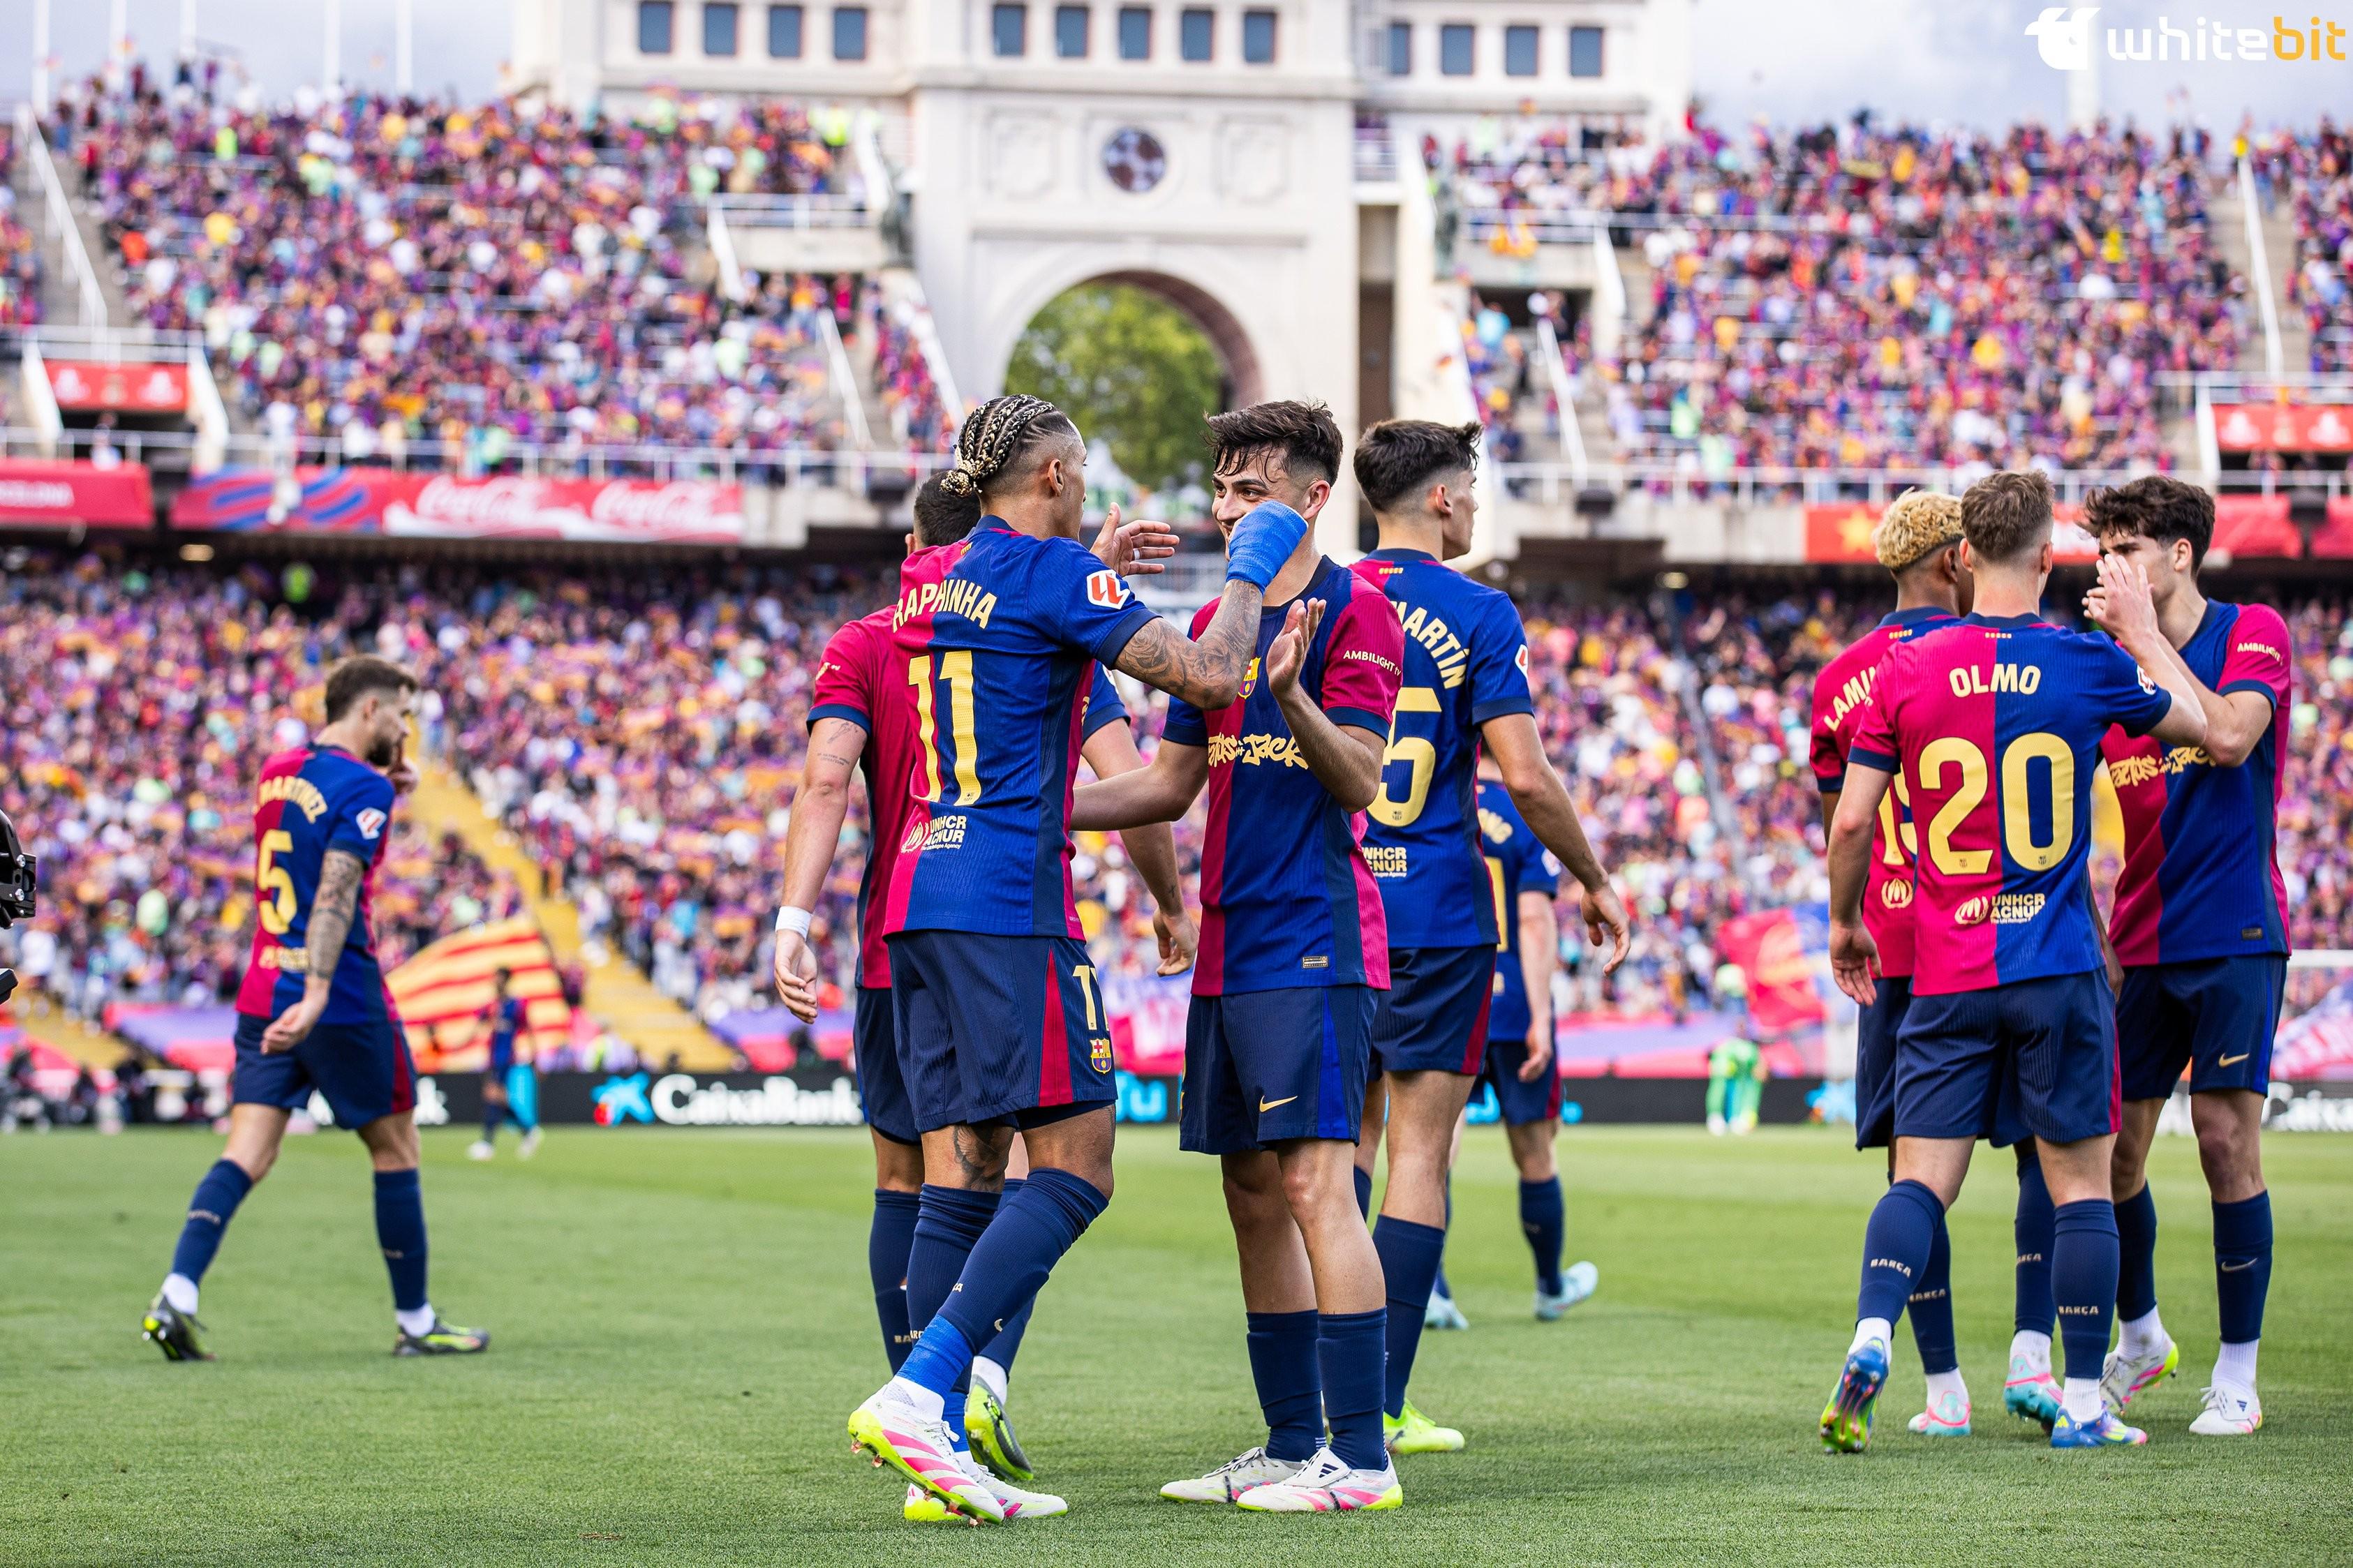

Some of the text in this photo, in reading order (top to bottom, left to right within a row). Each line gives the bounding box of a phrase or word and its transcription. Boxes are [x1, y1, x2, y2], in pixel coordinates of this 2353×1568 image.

[893, 578, 997, 634] RAPHINHA
[1343, 650, 1395, 672] AMBILIGHT
[1949, 663, 2041, 698] OLMO
[908, 650, 981, 807] 11
[930, 815, 967, 833] UNHCR
[1919, 732, 2074, 876] 20
[258, 829, 297, 934] 5
[1991, 893, 2045, 906] UNHCR
[651, 1073, 861, 1125] CaixaBank
